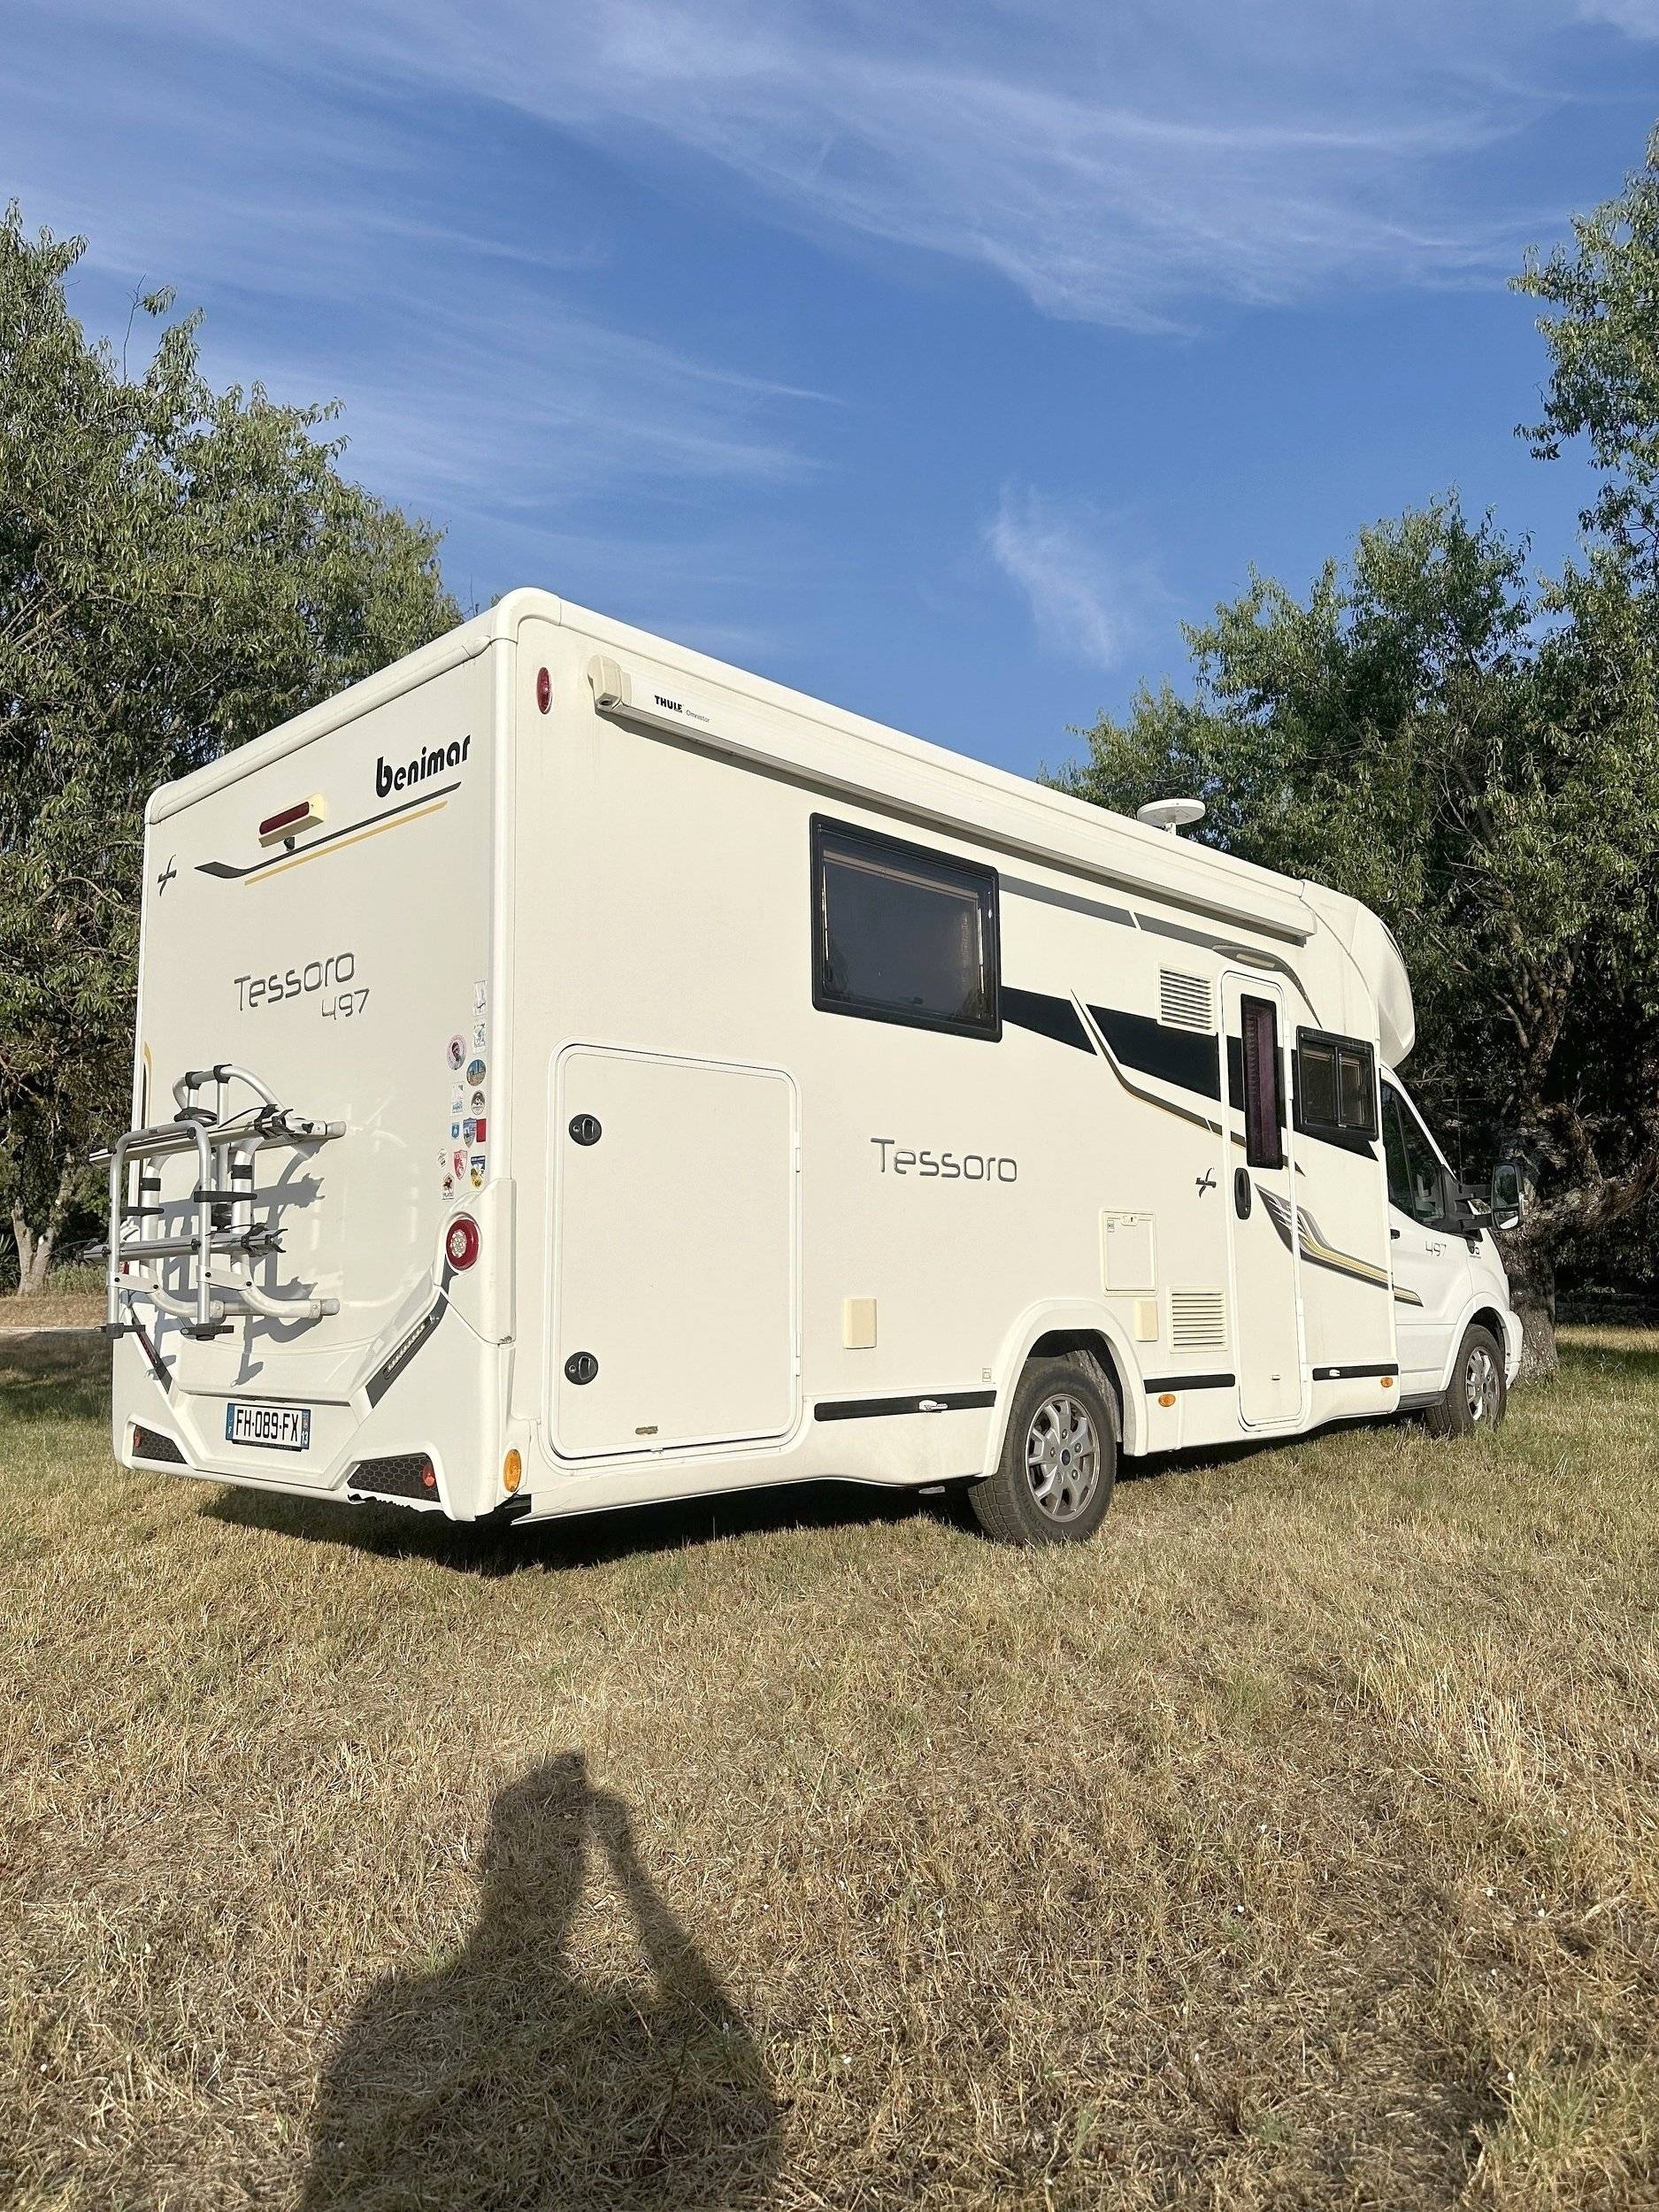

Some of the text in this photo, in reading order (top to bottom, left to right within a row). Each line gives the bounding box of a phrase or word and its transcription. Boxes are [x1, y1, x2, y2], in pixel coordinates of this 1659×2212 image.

[655, 695, 682, 710] THULE
[376, 734, 471, 797] benimar
[234, 952, 355, 1011] Tessoro
[321, 987, 370, 1020] 497
[871, 1137, 1018, 1182] Tessoro
[1425, 1240, 1447, 1258] 497
[235, 1409, 299, 1442] FH-089-FX
[301, 1430, 309, 1445] 13
